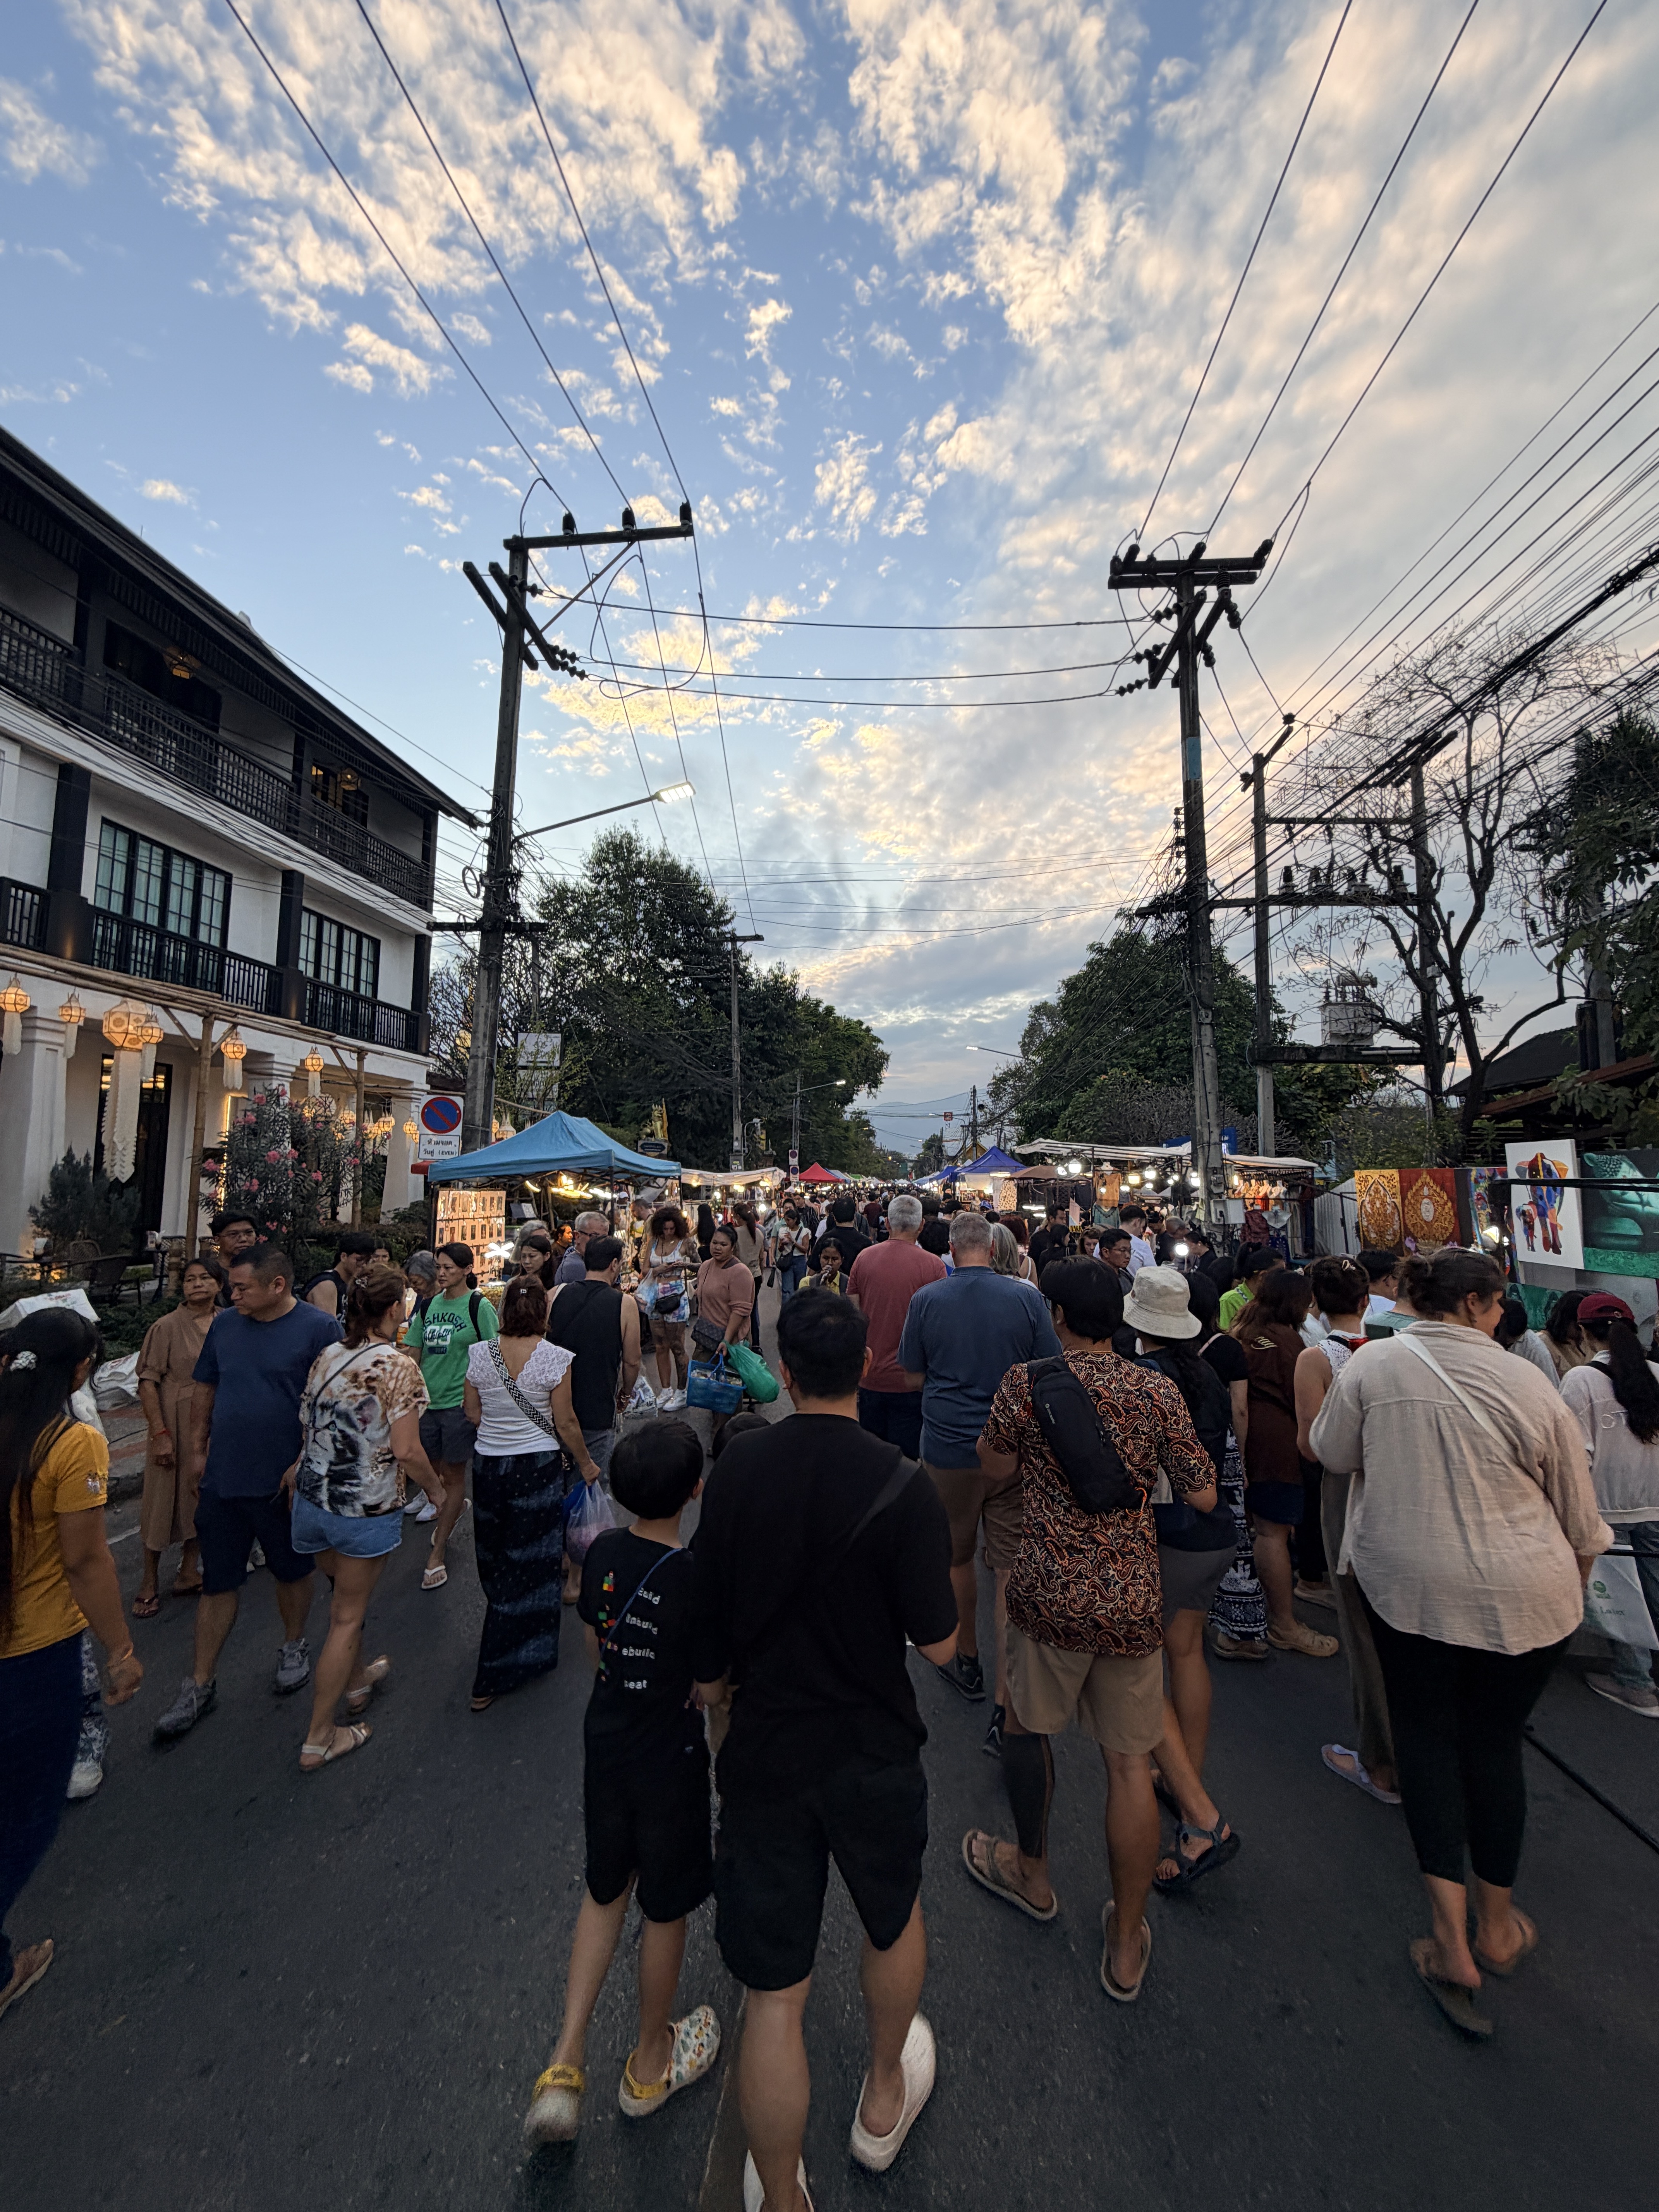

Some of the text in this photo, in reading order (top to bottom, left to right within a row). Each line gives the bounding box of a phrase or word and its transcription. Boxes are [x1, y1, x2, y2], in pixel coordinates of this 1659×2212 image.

[427, 1137, 453, 1146] ห้ามจอด
[424, 1312, 467, 1332] SHKOSH
